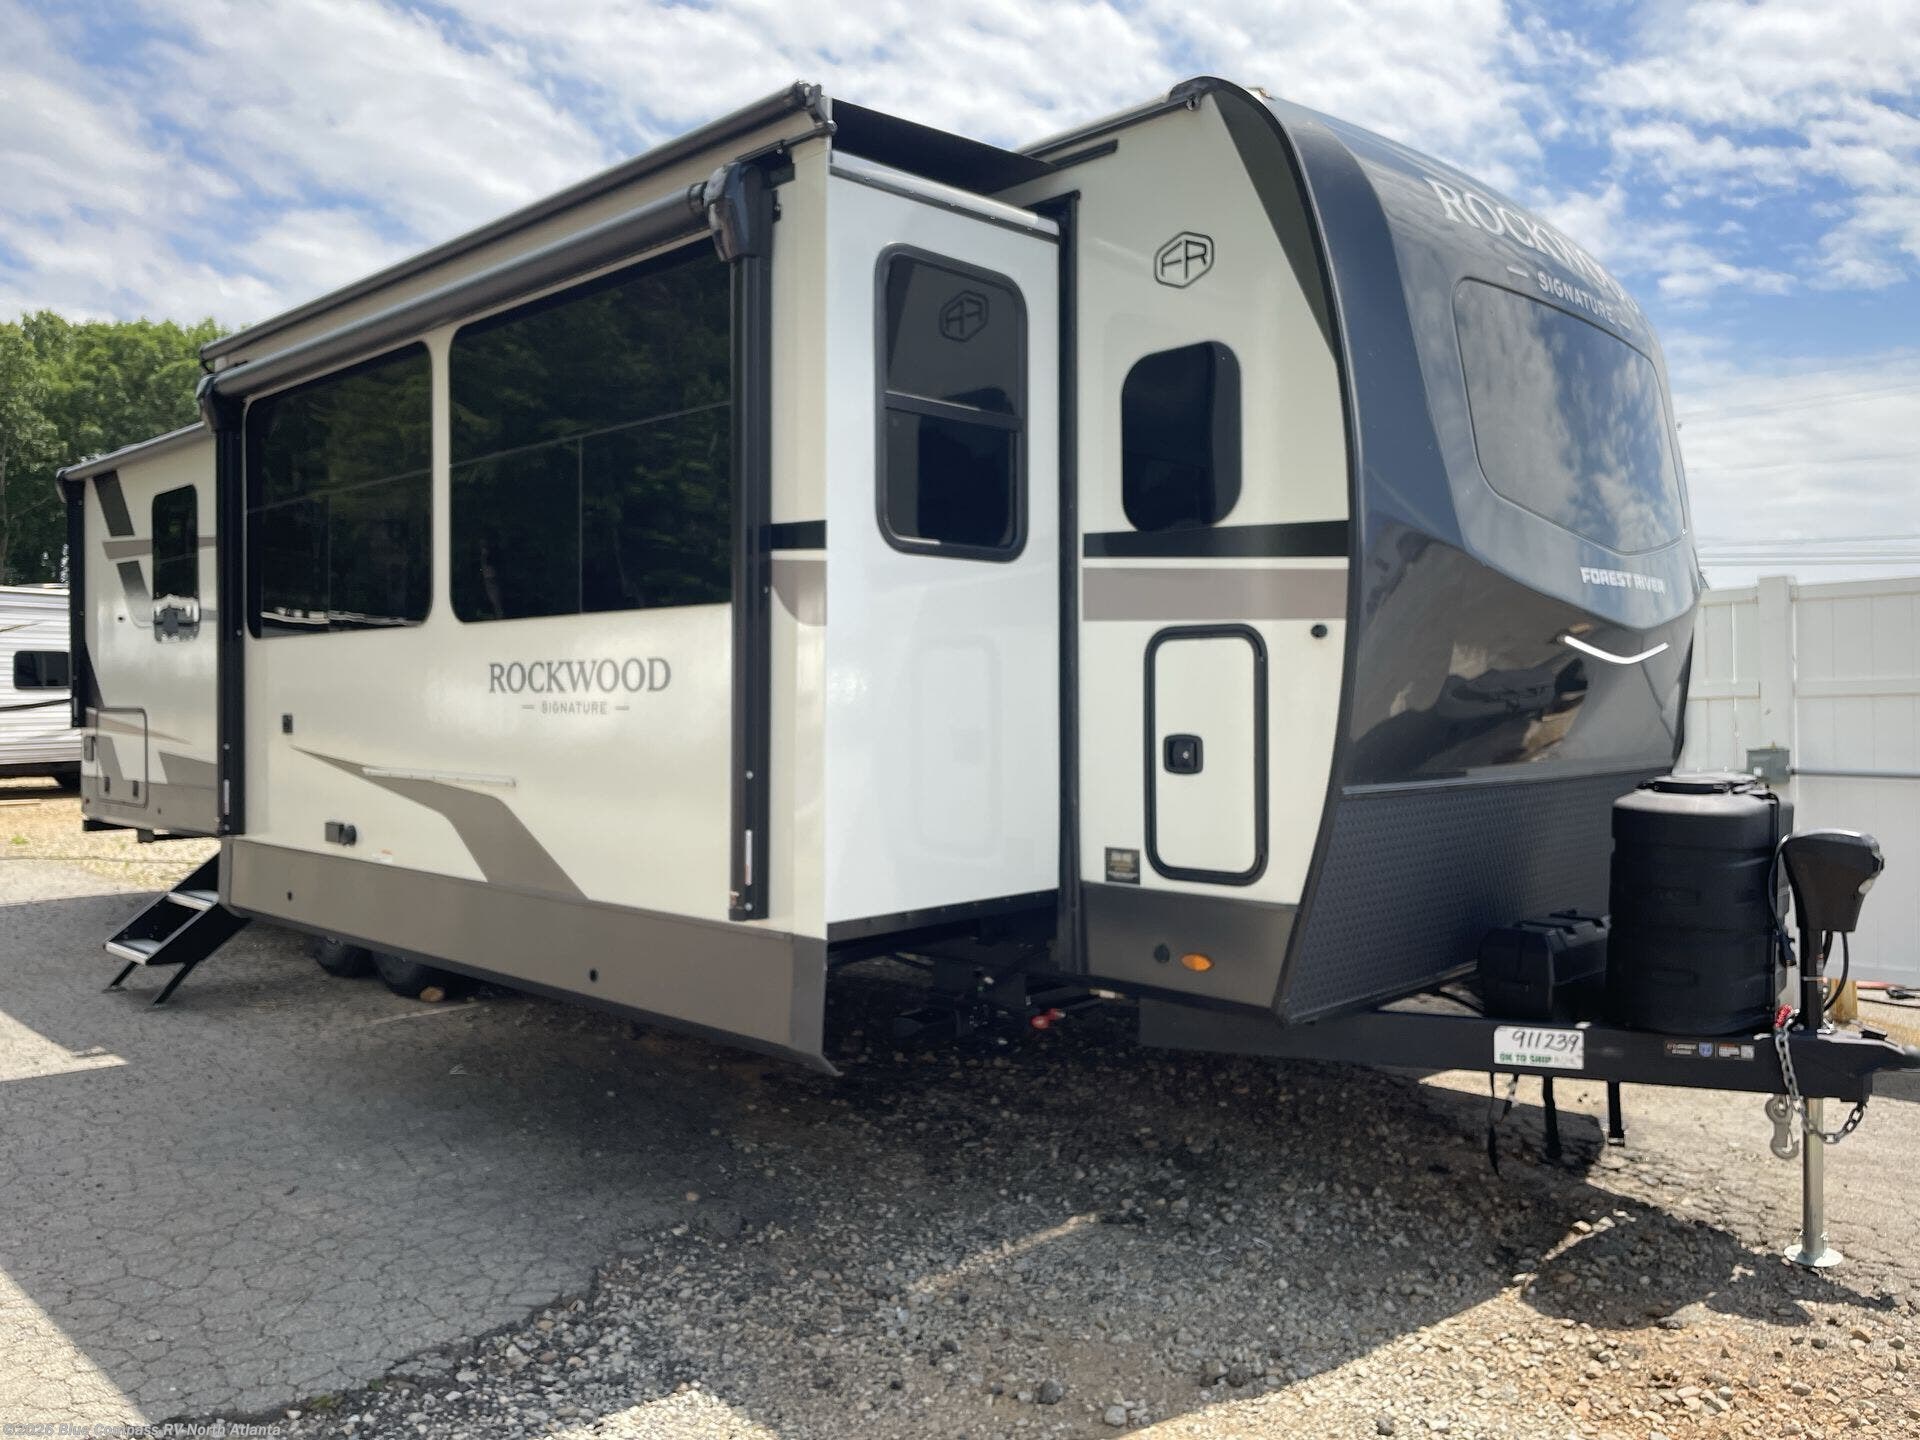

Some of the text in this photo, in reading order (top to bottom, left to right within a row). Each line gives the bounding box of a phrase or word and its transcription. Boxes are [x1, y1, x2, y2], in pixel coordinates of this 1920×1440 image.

[1537, 270, 1615, 325] SIGNATURE
[1580, 566, 1631, 588] FOREST
[489, 657, 671, 694] ROCKWOOD
[541, 701, 608, 715] SIGNATURE
[1512, 1030, 1579, 1053] 911239
